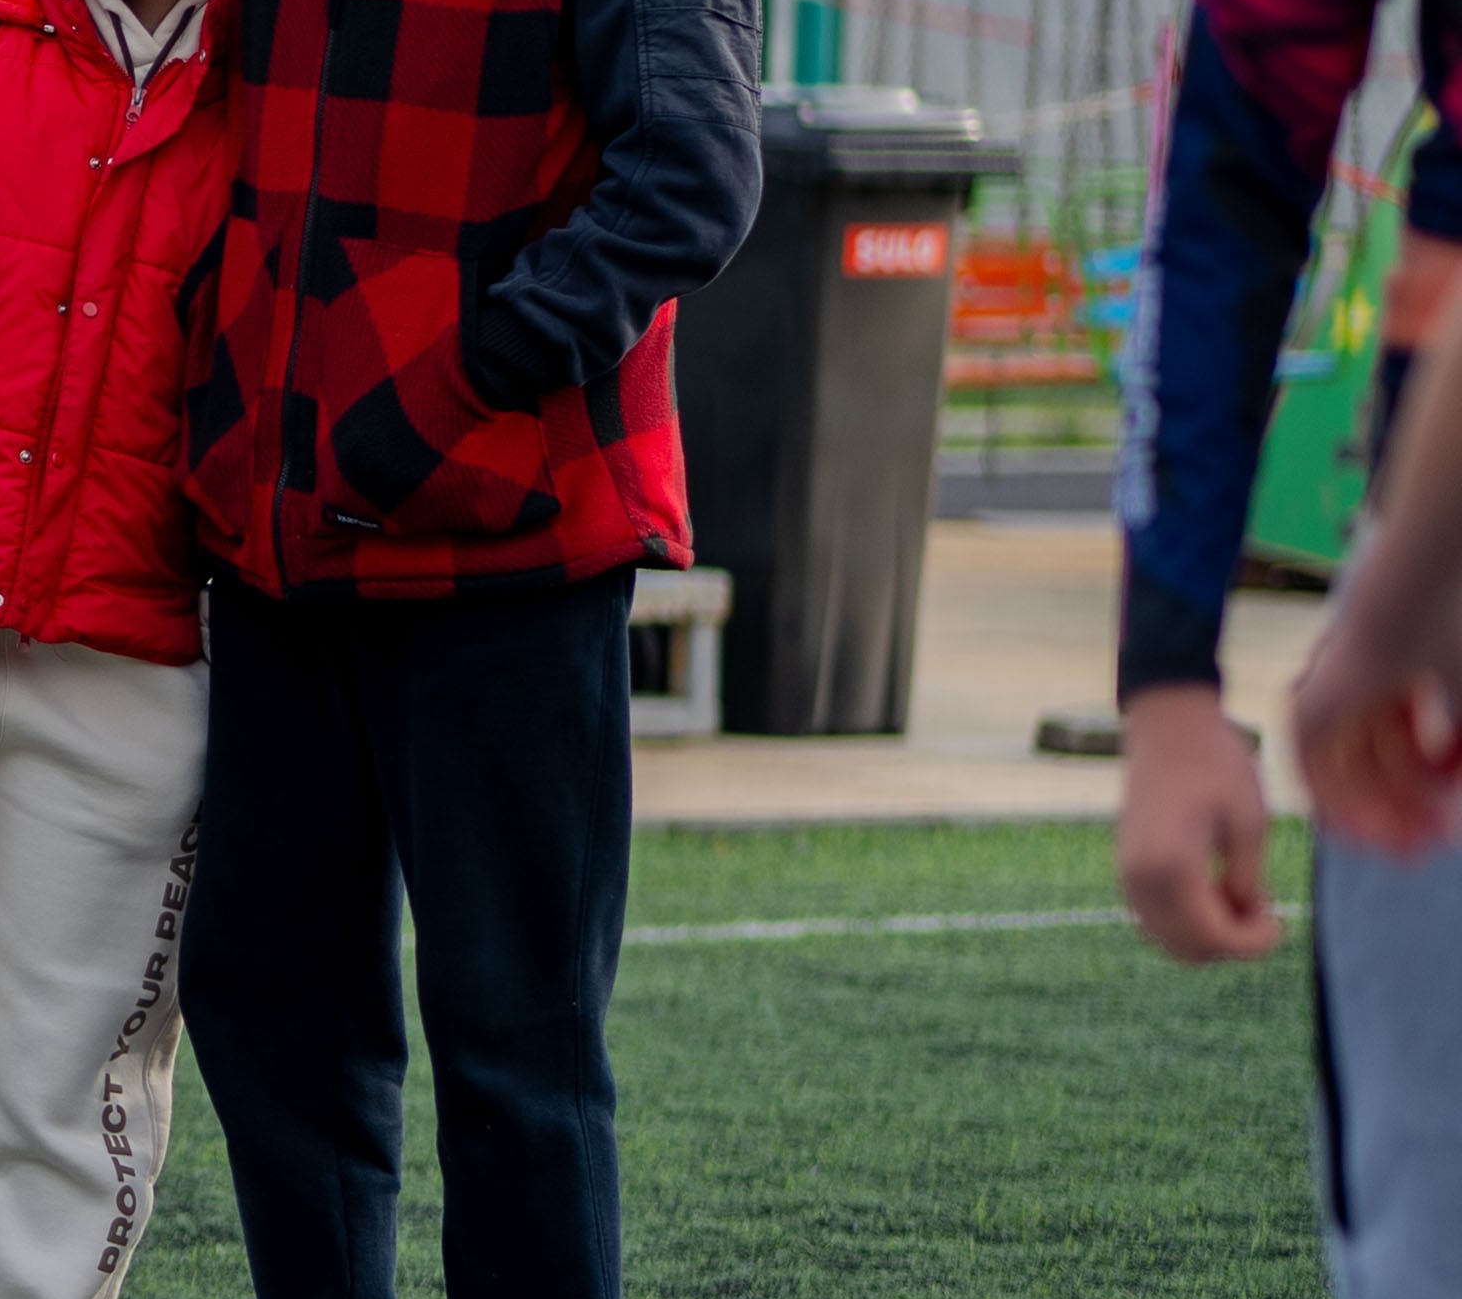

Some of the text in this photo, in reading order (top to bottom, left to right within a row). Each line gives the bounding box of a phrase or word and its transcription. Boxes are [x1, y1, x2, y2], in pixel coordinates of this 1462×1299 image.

[98, 798, 202, 1274] PROTECT YOUR PEAC
